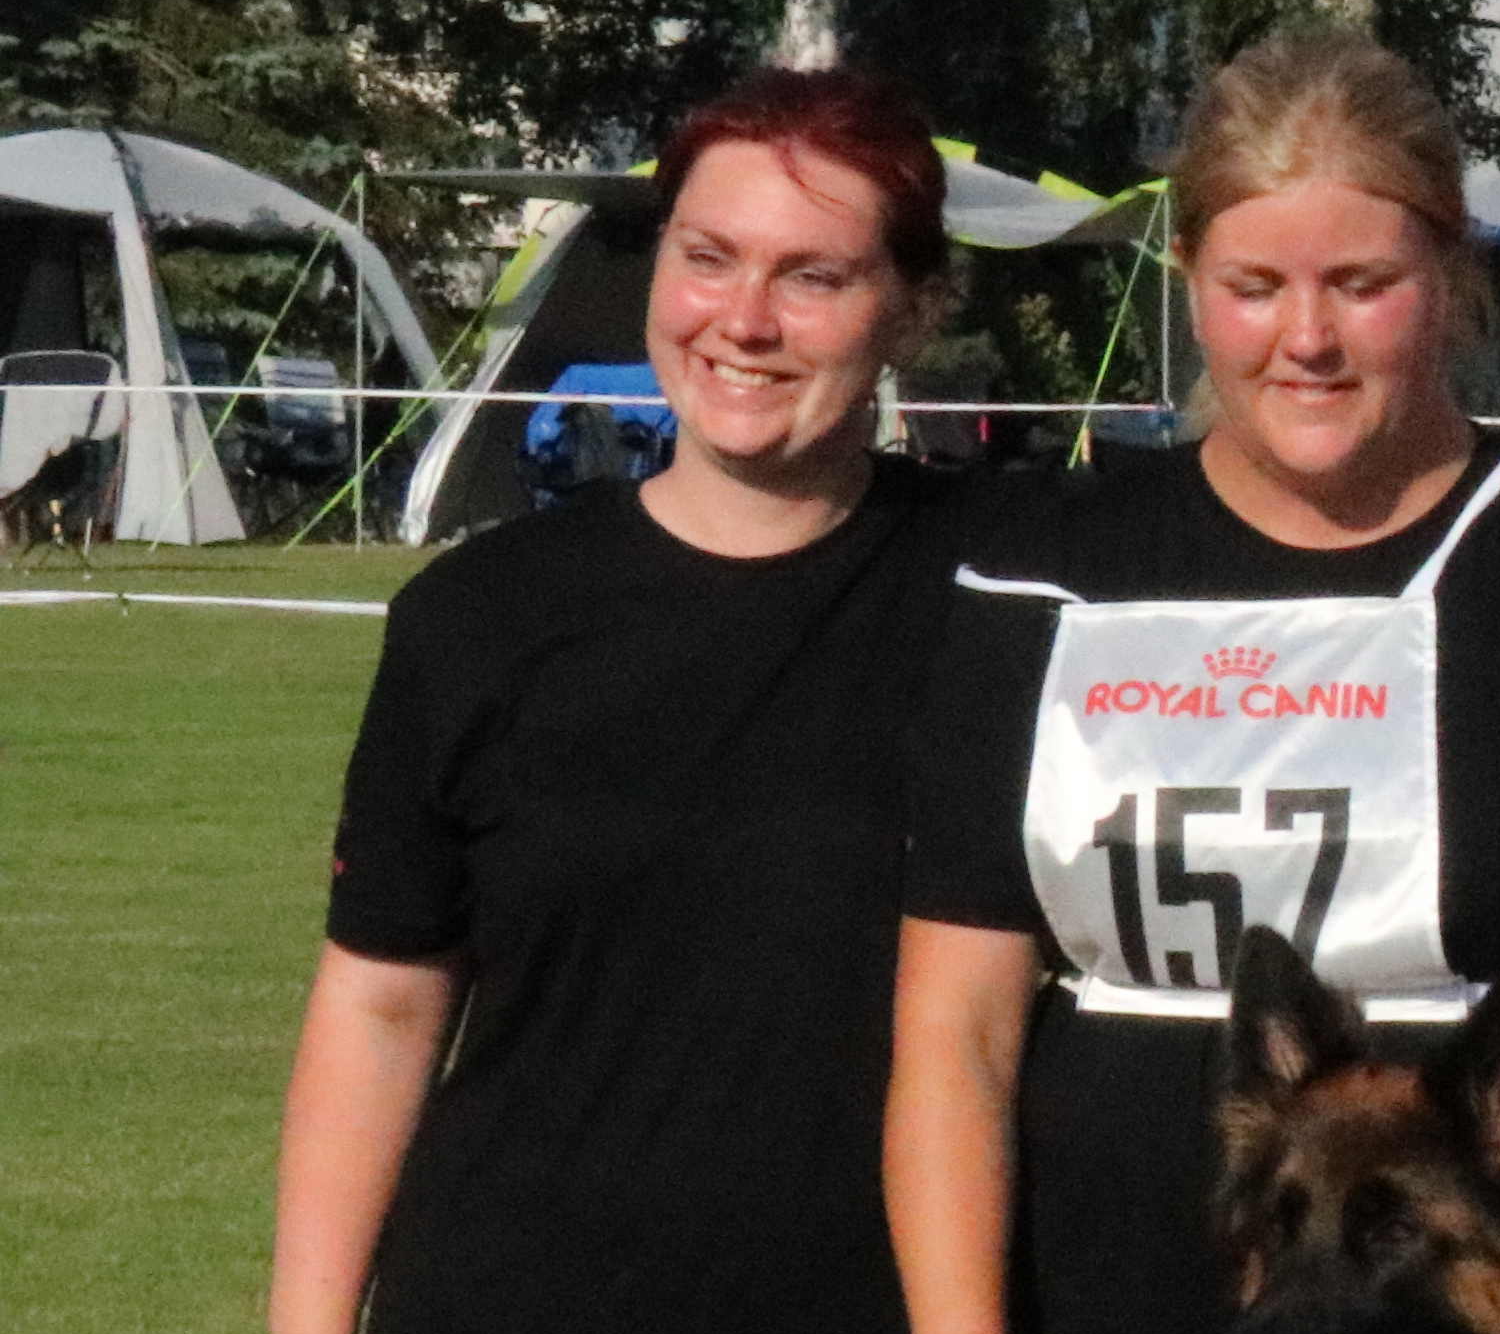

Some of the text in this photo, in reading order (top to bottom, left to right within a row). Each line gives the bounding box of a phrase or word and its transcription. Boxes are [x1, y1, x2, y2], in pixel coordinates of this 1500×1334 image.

[1084, 680, 1388, 720] ROYAL CANIN
[1093, 786, 1352, 989] 157
